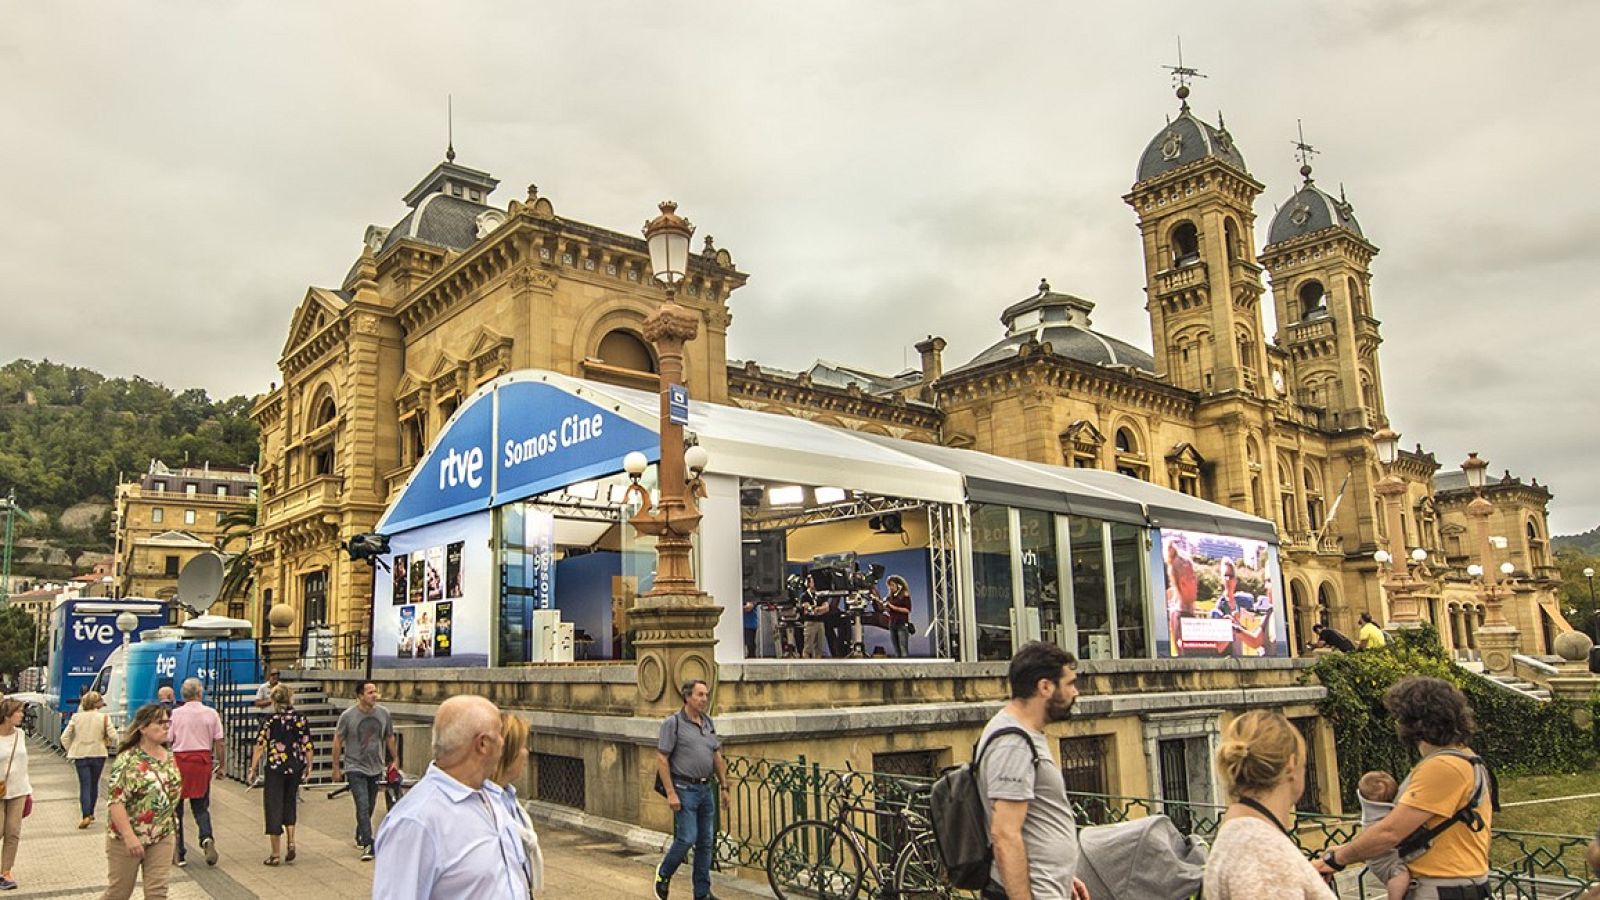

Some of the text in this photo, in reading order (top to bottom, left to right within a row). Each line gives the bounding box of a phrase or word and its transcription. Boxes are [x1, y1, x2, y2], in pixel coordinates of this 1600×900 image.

[504, 413, 603, 468] Somos Cine
[439, 446, 484, 490] rtve
[72, 619, 114, 644] tve
[155, 653, 177, 677] tve
